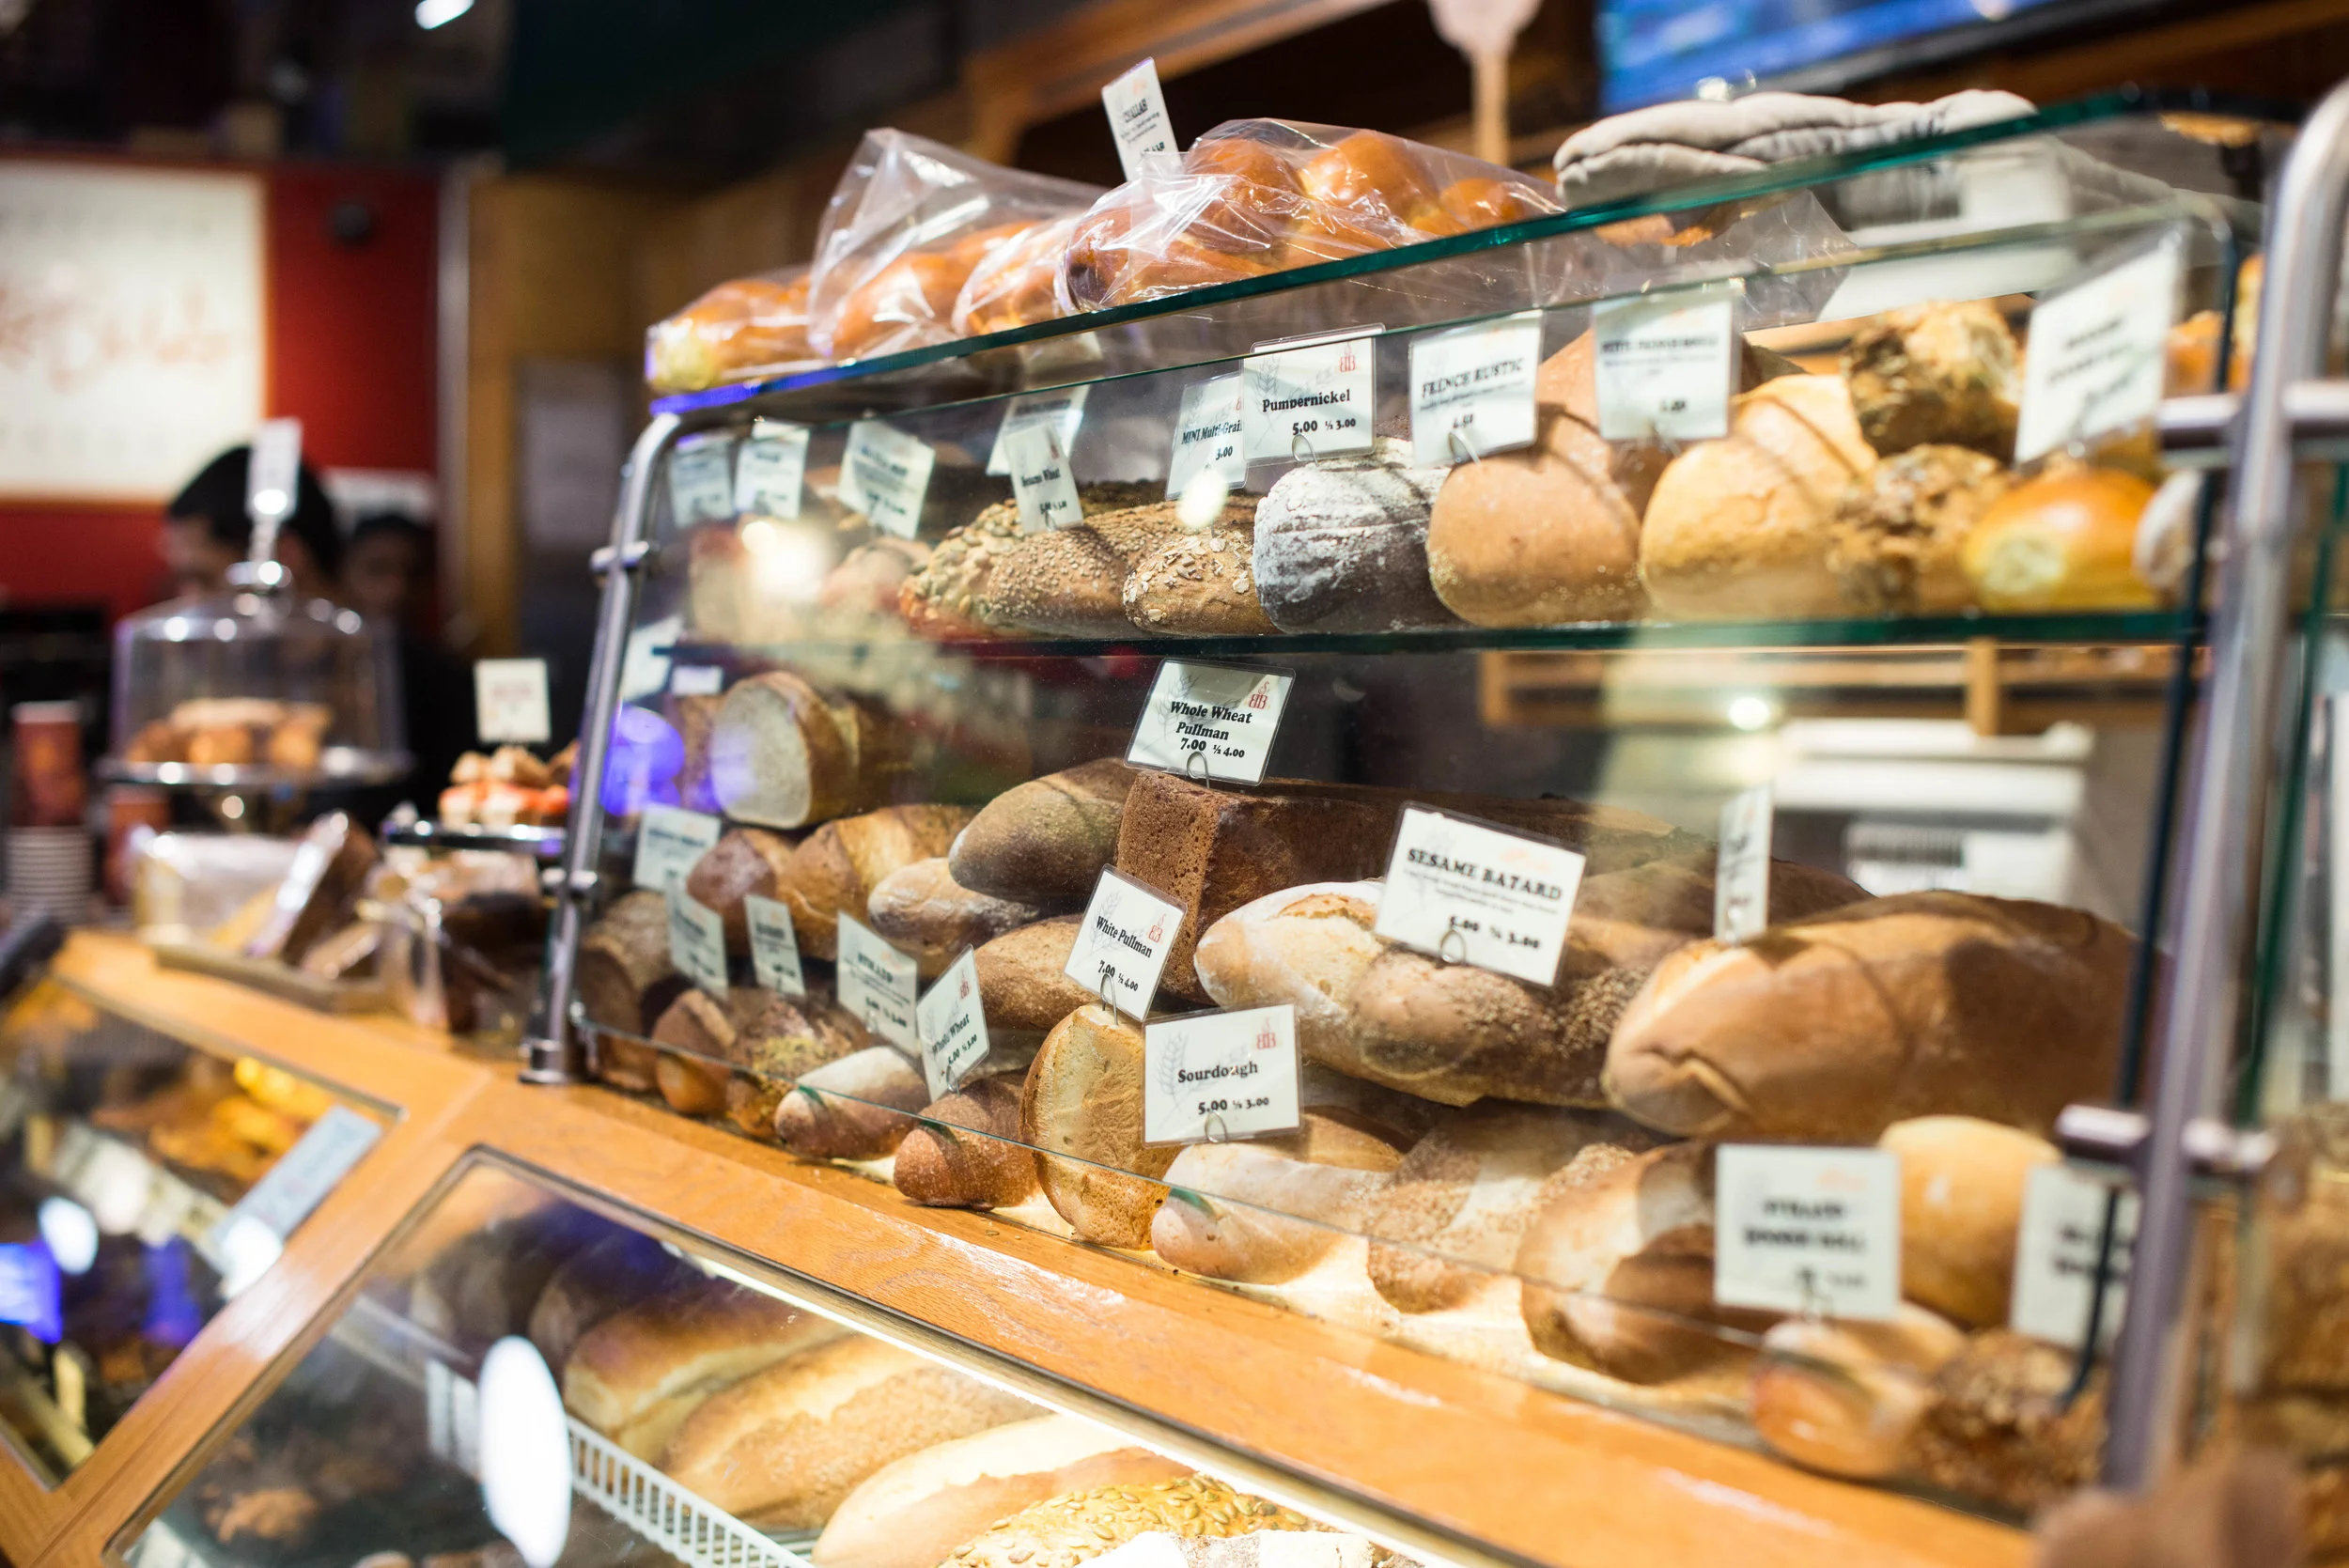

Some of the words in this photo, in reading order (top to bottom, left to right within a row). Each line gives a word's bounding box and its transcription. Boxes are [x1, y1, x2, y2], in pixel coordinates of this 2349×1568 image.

[1262, 388, 1350, 412] Pumpernickel
[1181, 429, 1201, 445] MINI
[1292, 420, 1317, 435] 5.00
[1335, 418, 1356, 430] 3.00
[1216, 445, 1233, 460] 3.00
[1170, 701, 1208, 718] Whole
[1211, 706, 1252, 723] Wheat
[1175, 722, 1229, 740] Pullman
[1180, 737, 1206, 752] 7.00
[1222, 747, 1245, 758] 4.00
[1407, 847, 1479, 877] SESAME
[1482, 868, 1563, 901] BATARD
[1096, 915, 1118, 939] White
[1118, 928, 1153, 958] Pullman
[1097, 959, 1115, 978] 7.00
[1124, 978, 1139, 992] 4.00
[931, 1032, 950, 1057] Whole
[949, 1013, 970, 1037] Wheat
[1177, 1061, 1258, 1083] Sourdough
[1198, 1099, 1228, 1115] 5.00
[1246, 1097, 1269, 1109] 3.00
